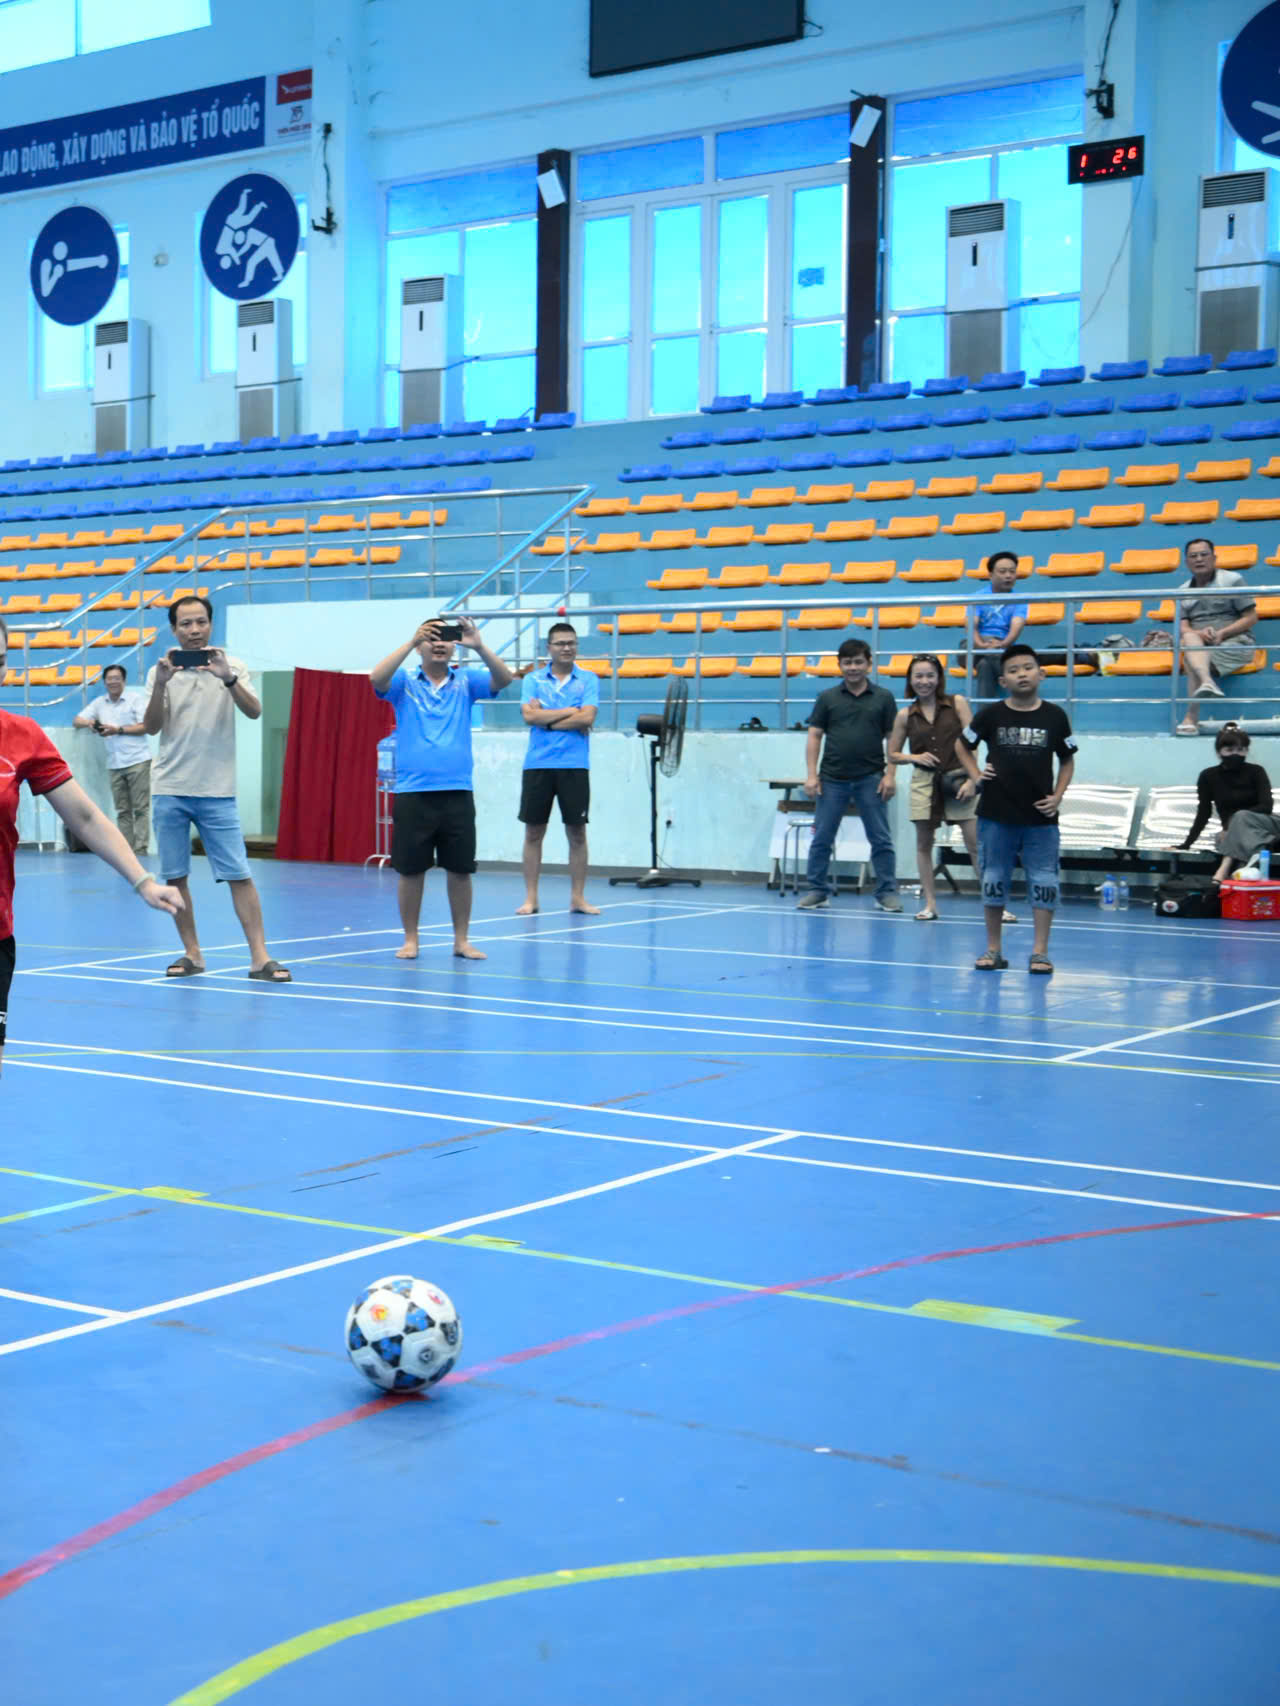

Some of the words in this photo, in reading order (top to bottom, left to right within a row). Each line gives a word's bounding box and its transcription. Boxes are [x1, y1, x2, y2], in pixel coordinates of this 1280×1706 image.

[21, 139, 60, 178] ĐỘNG,
[62, 131, 88, 166] XÂY
[90, 128, 126, 165] DỰNG
[129, 118, 147, 153] VÀ
[150, 110, 178, 150] BẢO
[181, 108, 198, 148] VỆ
[201, 98, 219, 139] TỔ
[222, 92, 260, 138] QUỐC
